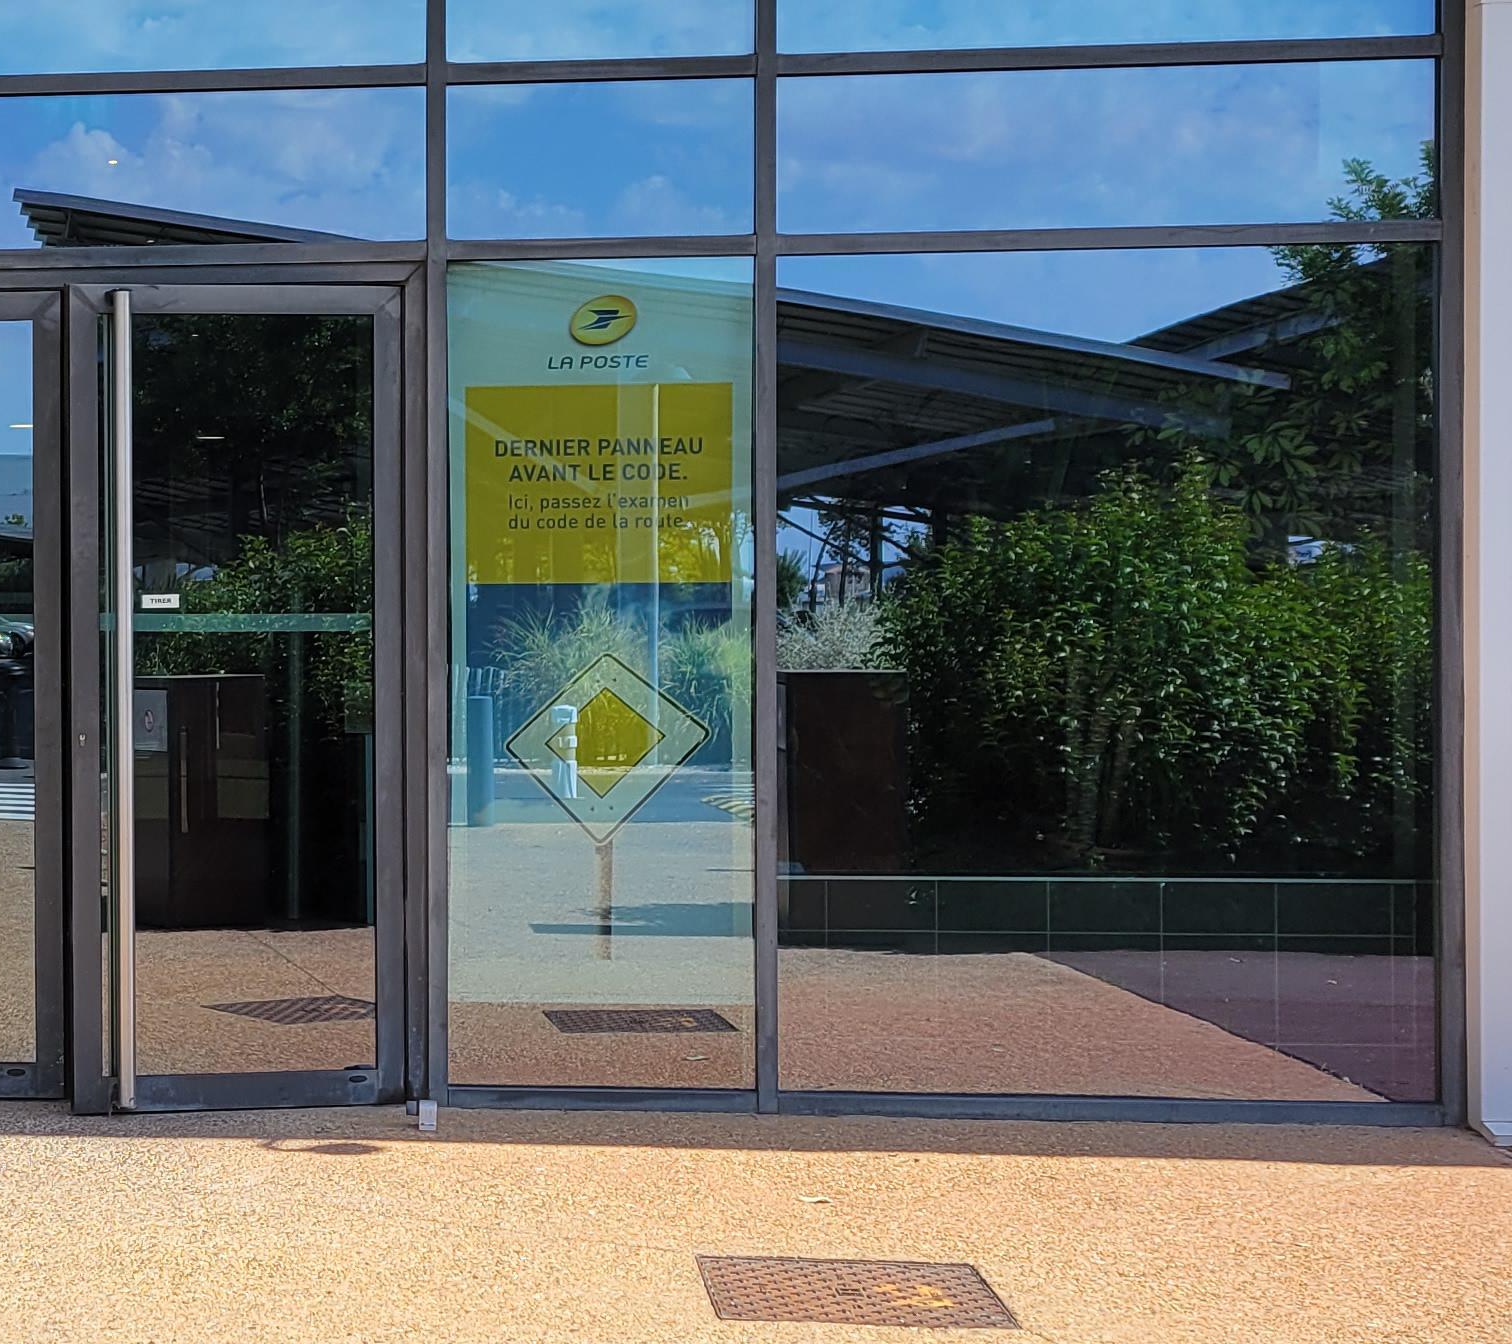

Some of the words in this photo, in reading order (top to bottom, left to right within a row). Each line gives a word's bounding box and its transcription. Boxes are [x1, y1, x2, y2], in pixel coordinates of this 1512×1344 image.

[547, 355, 574, 370] LA
[580, 354, 649, 370] POSTE
[494, 438, 591, 457] DERNIER
[597, 437, 703, 456] PANNEAU
[508, 464, 581, 482] AVANT
[588, 464, 615, 481] LE
[622, 463, 687, 481] CODE.
[508, 494, 534, 511] Ici,
[540, 496, 601, 512] passez
[508, 514, 530, 529] du
[536, 514, 578, 529] code
[585, 514, 606, 529] de
[612, 514, 628, 529] la
